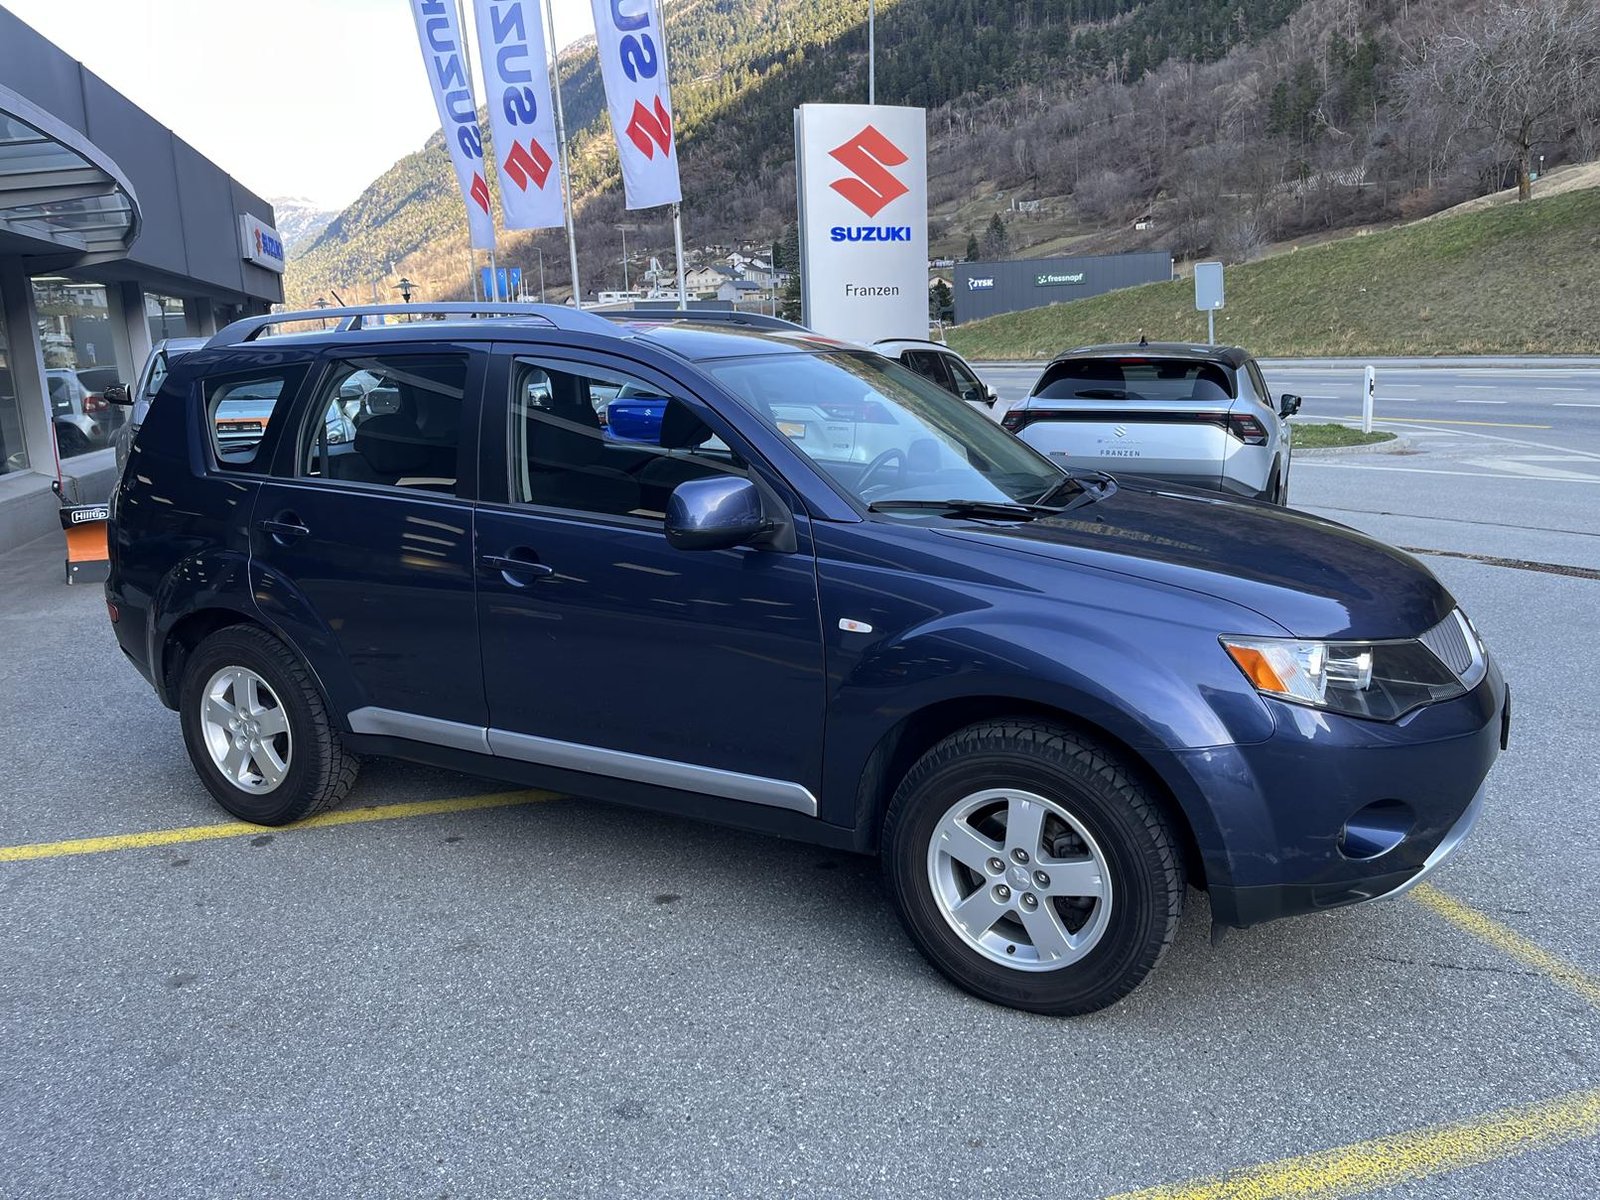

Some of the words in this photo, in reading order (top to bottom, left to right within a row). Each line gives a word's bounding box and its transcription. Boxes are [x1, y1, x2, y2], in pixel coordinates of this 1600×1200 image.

[830, 226, 911, 242] SUZUKI
[846, 284, 899, 296] Franzen
[1100, 449, 1140, 457] FRANZEN
